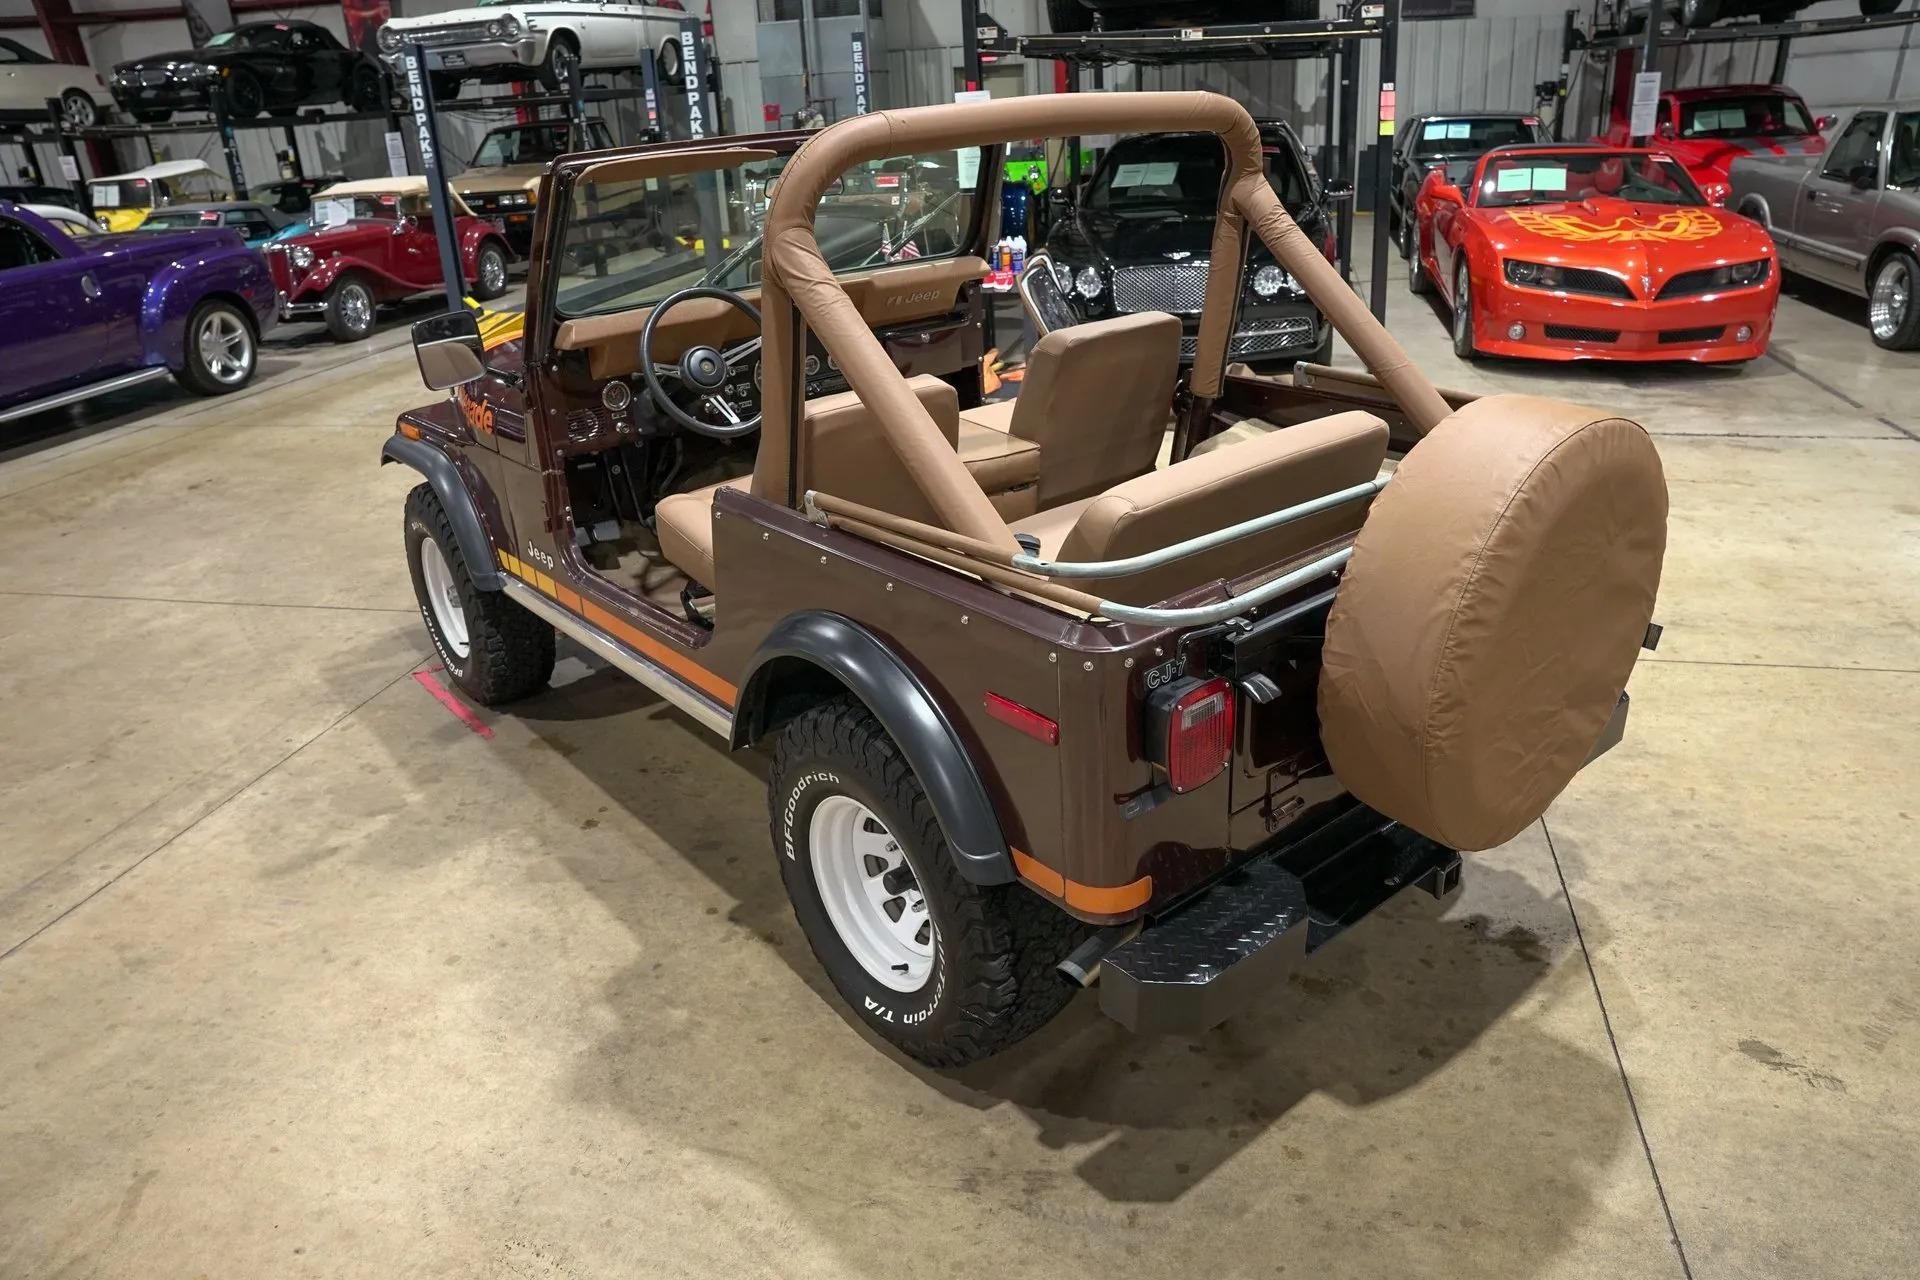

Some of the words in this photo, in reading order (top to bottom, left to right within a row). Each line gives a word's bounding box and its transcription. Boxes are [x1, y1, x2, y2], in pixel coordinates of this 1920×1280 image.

[405, 56, 432, 152] BENDPAK
[681, 31, 704, 134] BENDPAK
[852, 41, 866, 115] BENDPAK
[905, 289, 940, 304] Jeep
[527, 540, 554, 570] Jeep
[1147, 655, 1187, 689] CJ-7
[784, 771, 840, 861] BFGoodrich
[864, 995, 894, 1023] T/A
